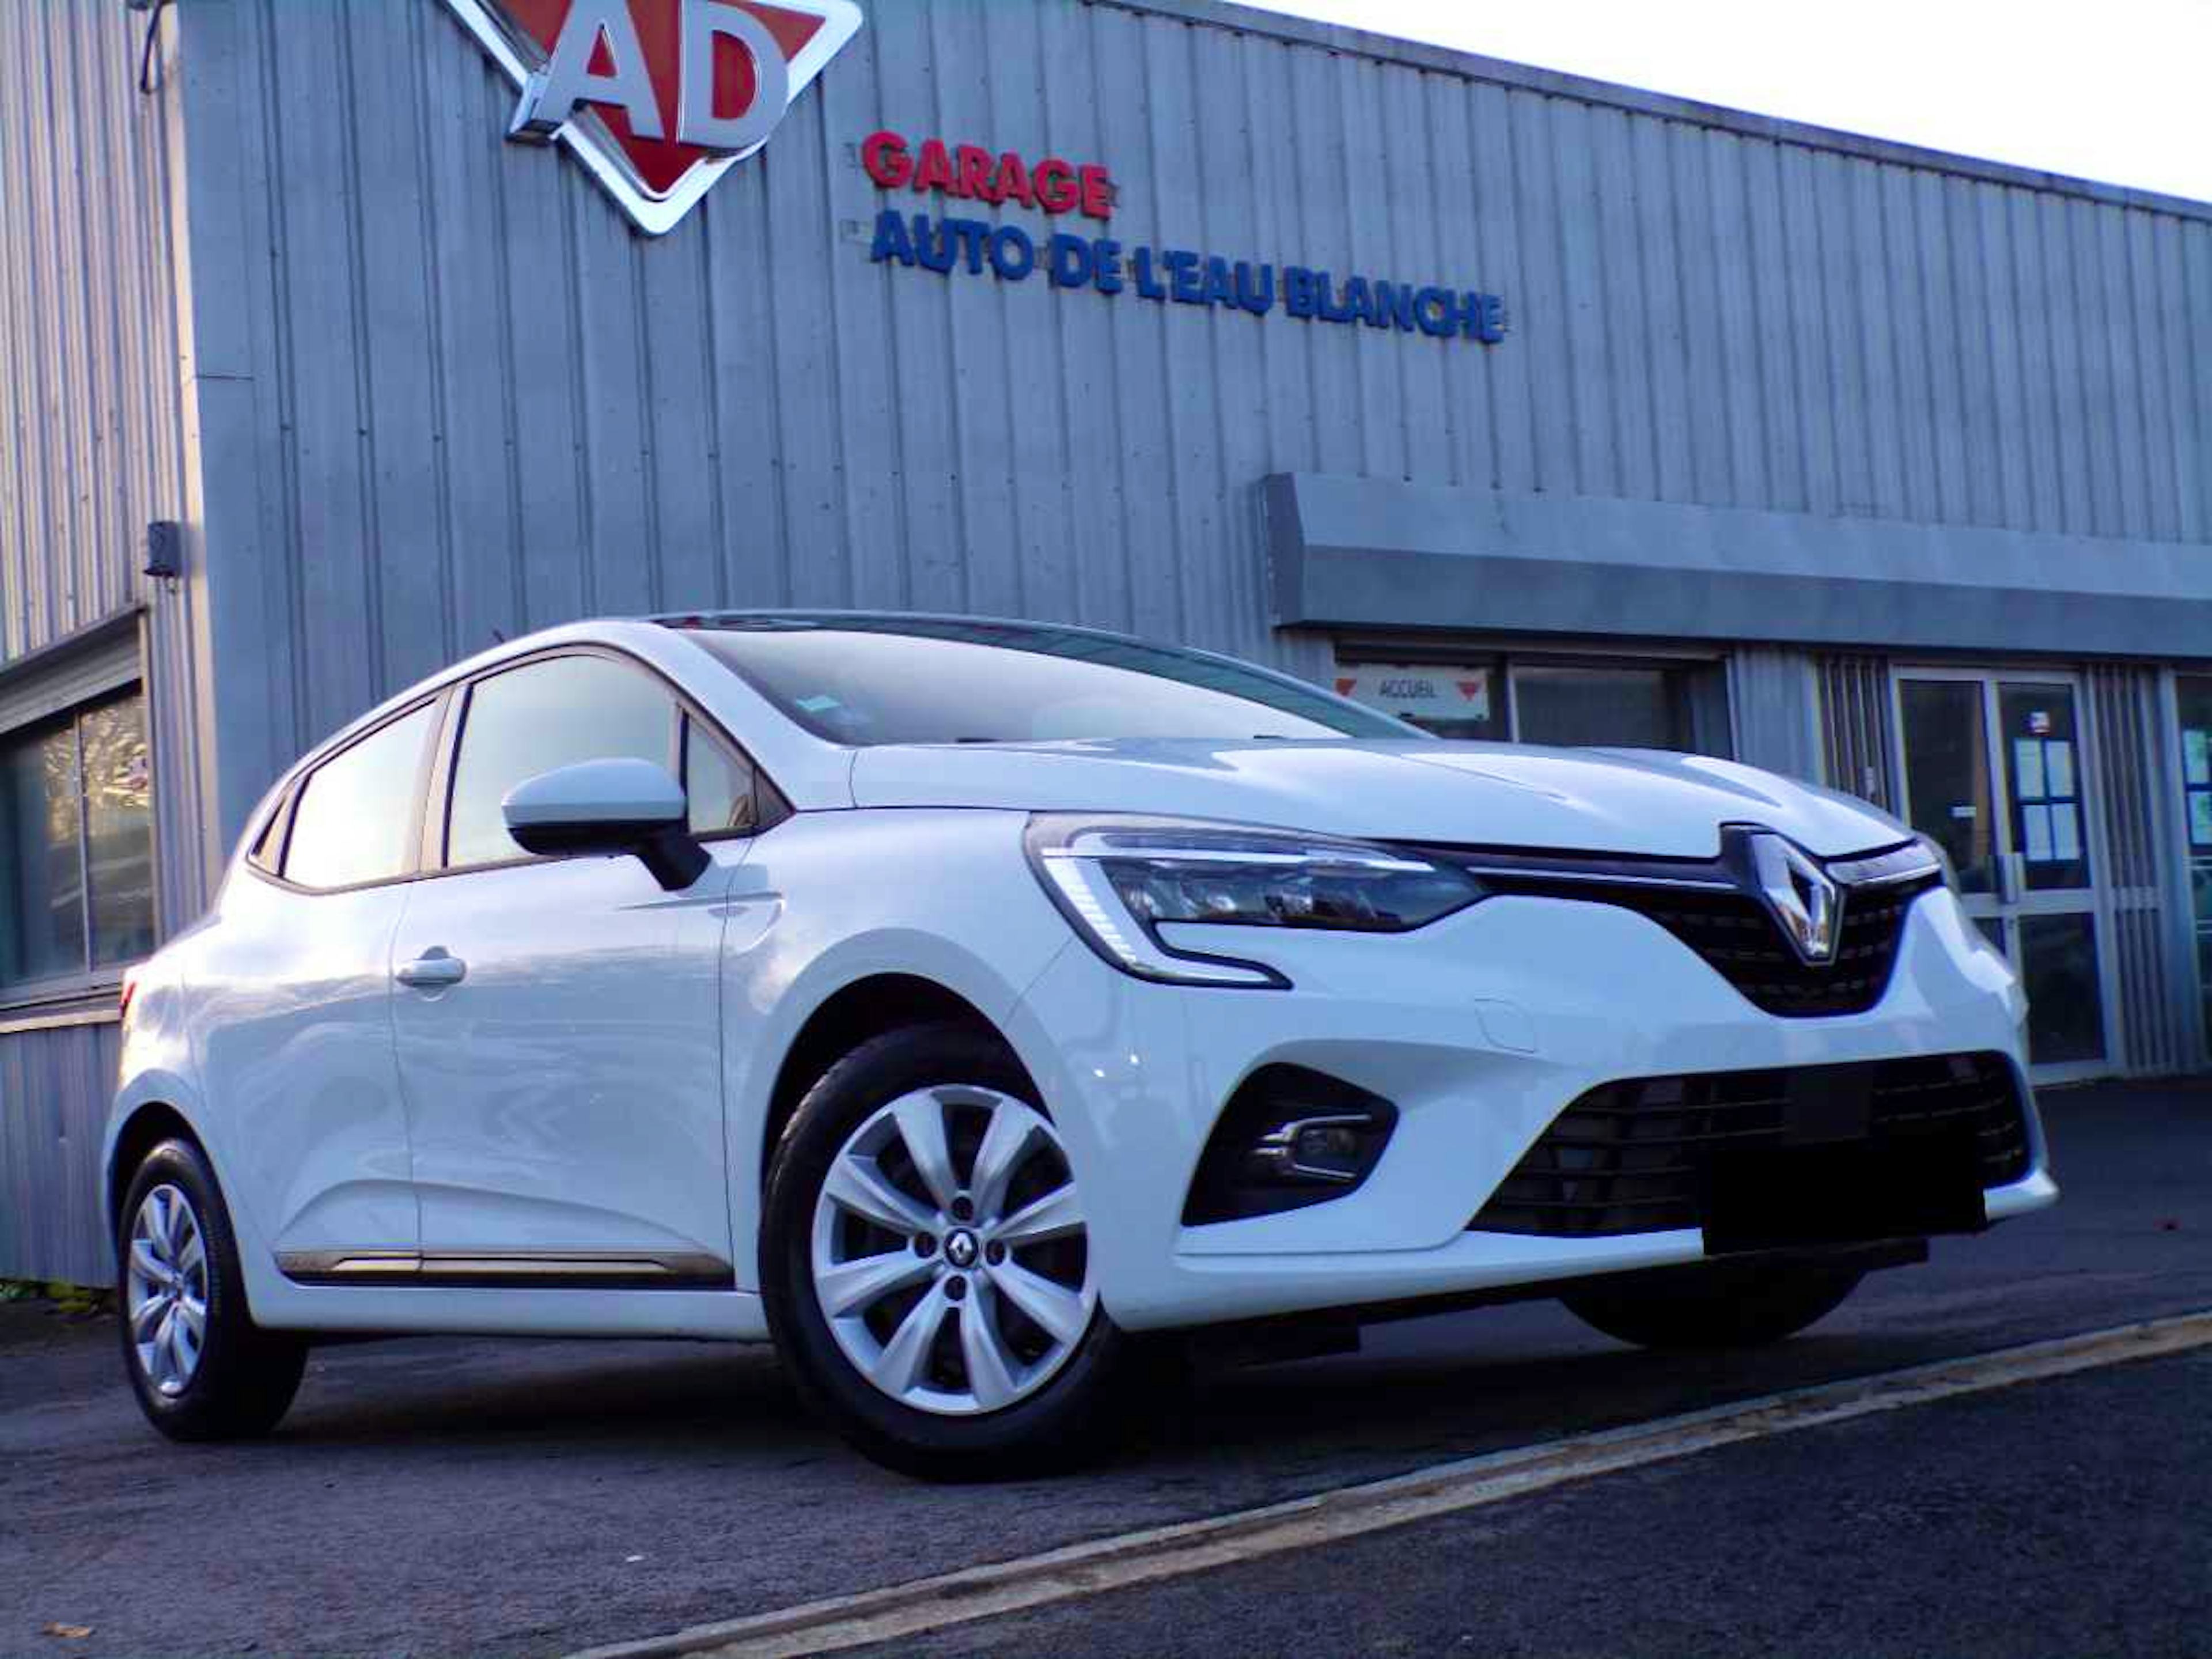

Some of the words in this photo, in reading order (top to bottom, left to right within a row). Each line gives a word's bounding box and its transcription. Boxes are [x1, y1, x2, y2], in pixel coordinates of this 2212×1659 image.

[521, 0, 789, 149] AD
[861, 131, 1113, 219] GARAGE
[870, 208, 1035, 280] AUTO
[1050, 232, 1123, 295] DE
[1137, 246, 1275, 315] L'EAU
[1285, 266, 1505, 344] BLANCHE
[1379, 679, 1436, 698] ACCUEIL
